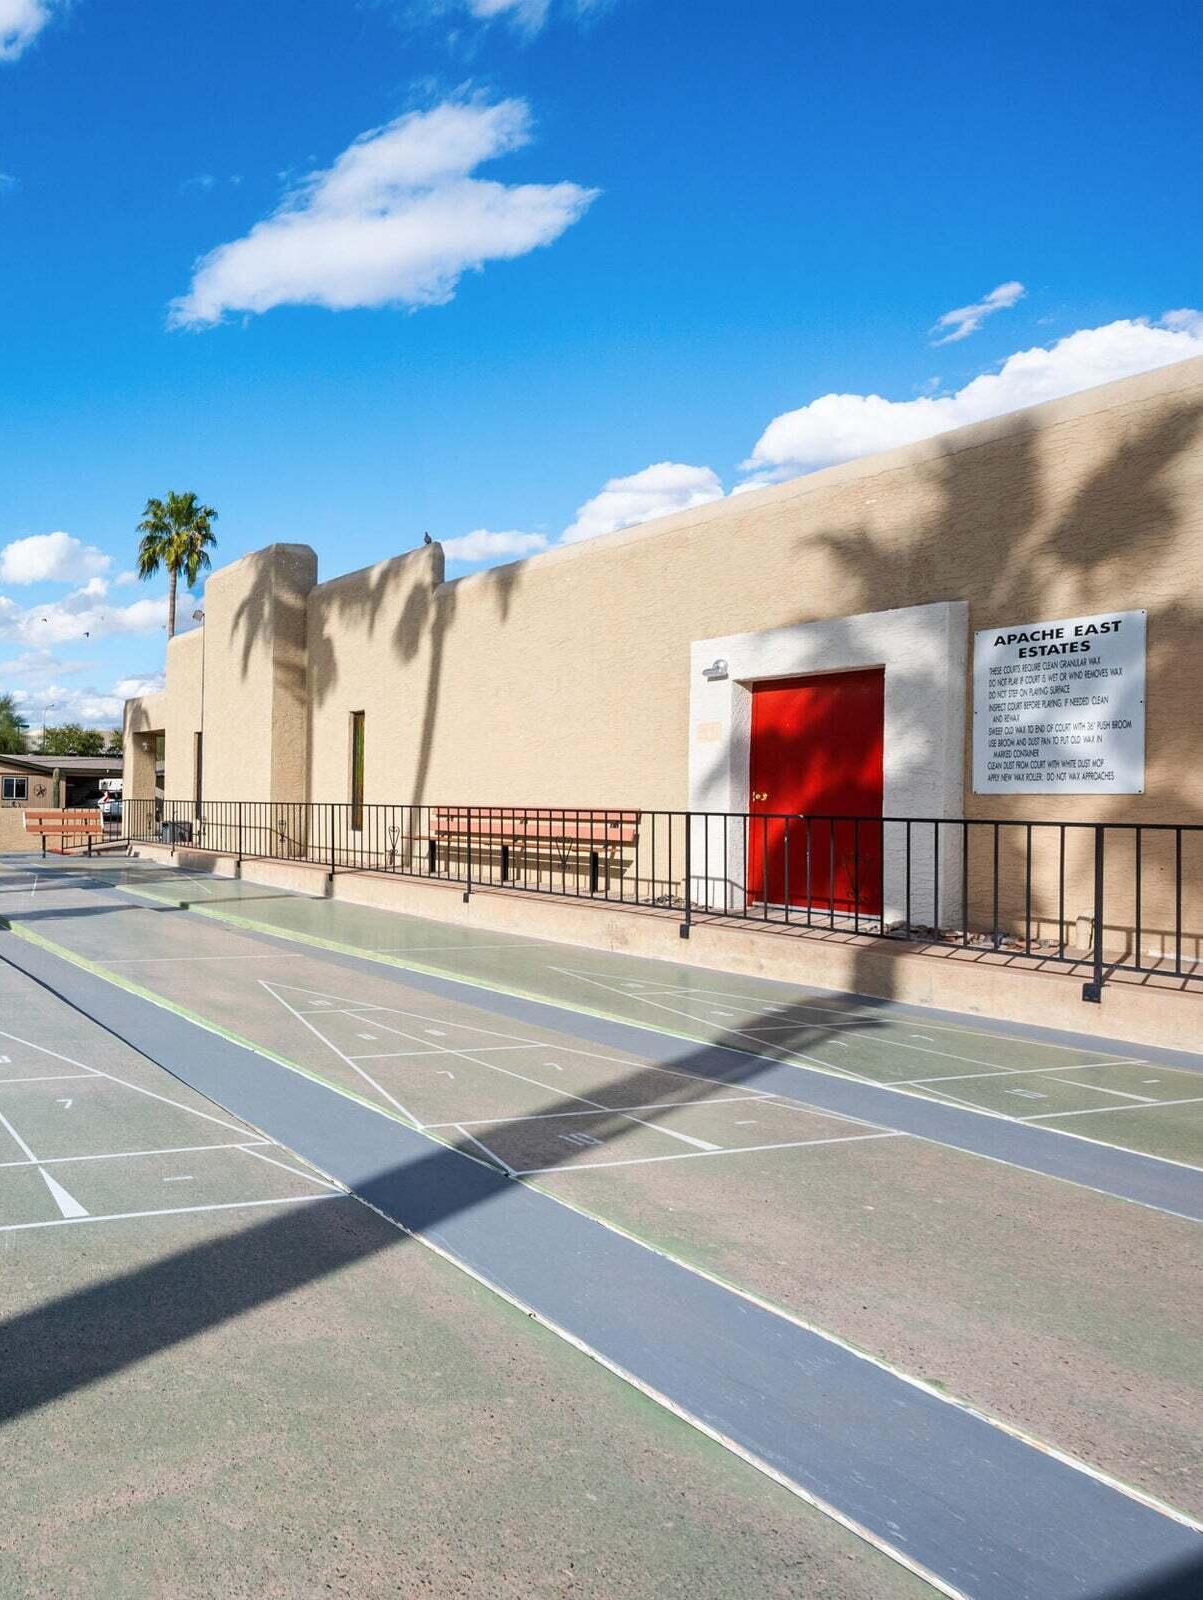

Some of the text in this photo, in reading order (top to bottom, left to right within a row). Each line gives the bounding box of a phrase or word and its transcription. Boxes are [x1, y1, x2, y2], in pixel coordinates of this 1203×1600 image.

[994, 620, 1122, 647] APACHE EAST
[1018, 640, 1091, 659] ESTATES
[1003, 664, 1021, 674] COURTS
[1022, 663, 1041, 673] REQUIRE
[1042, 661, 1059, 671] CLEAN
[1059, 658, 1087, 669] GRANULAR
[1088, 656, 1101, 665] WAX
[1024, 675, 1041, 685] COURT
[1068, 670, 1083, 680] WIND
[1084, 668, 1109, 679] REMOVES
[1110, 667, 1123, 676] WAX
[1029, 686, 1048, 697] PLAYING
[1049, 684, 1071, 695] SURFACE
[989, 702, 1006, 712] INSPECT
[1007, 701, 1023, 711] COURT
[1023, 699, 1040, 710] BEFORE
[1091, 695, 1109, 705] CLEAN
[1054, 722, 1072, 732] COURT
[1072, 721, 1086, 730] WITH
[1097, 720, 1111, 730] PUSH
[1111, 719, 1133, 730] BROOM
[997, 738, 1015, 748] BROOM
[1083, 735, 1096, 743] WAX
[993, 748, 1039, 759] MARKED CONTAINER
[987, 761, 1003, 770] CLEAN
[1015, 760, 1029, 769] FROM
[1030, 760, 1046, 769] COURT
[1047, 759, 1060, 769] WITH
[1061, 759, 1077, 768] WHITE
[1078, 759, 1091, 768] DUST
[1068, 771, 1081, 780] WAX
[1082, 770, 1115, 780] APPROACHES
[56, 1098, 74, 1109] 7
